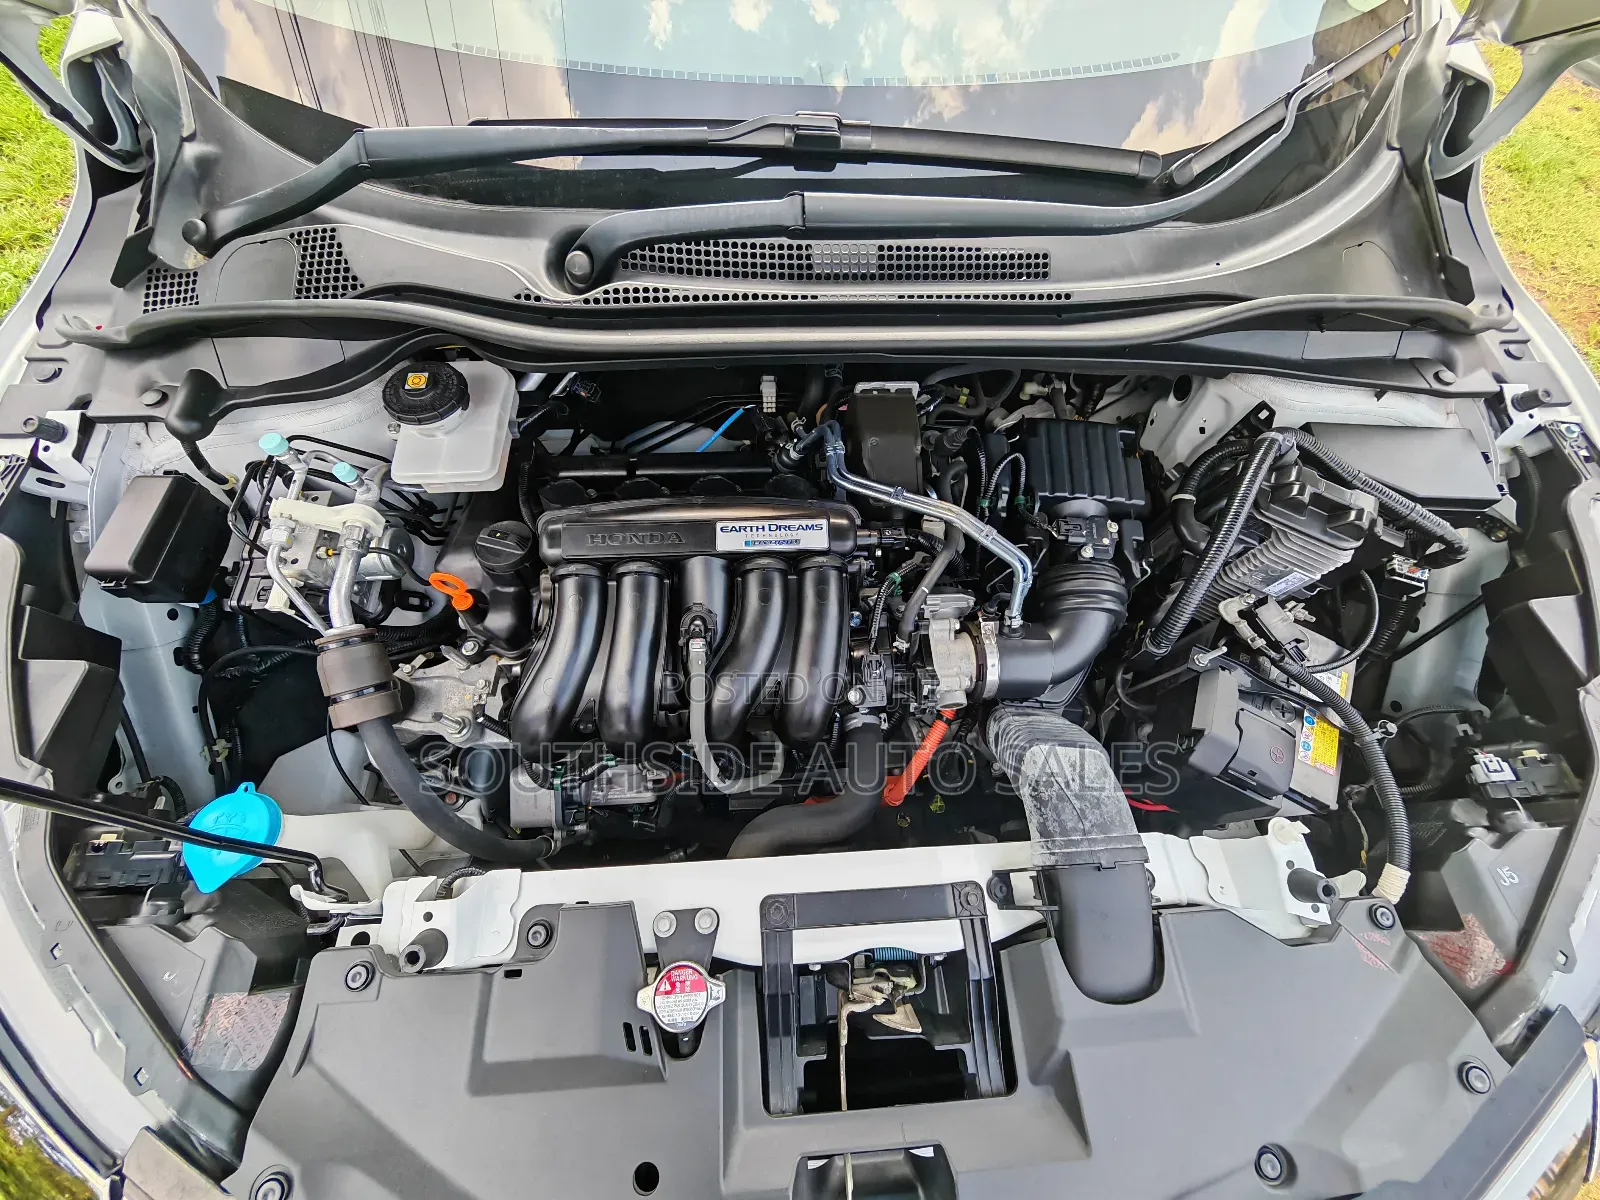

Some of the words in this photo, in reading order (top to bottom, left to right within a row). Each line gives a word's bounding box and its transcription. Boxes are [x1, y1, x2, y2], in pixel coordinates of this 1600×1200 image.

[720, 525, 765, 533] EARTH
[768, 523, 823, 532] DREAMS
[586, 531, 686, 547] HONDA
